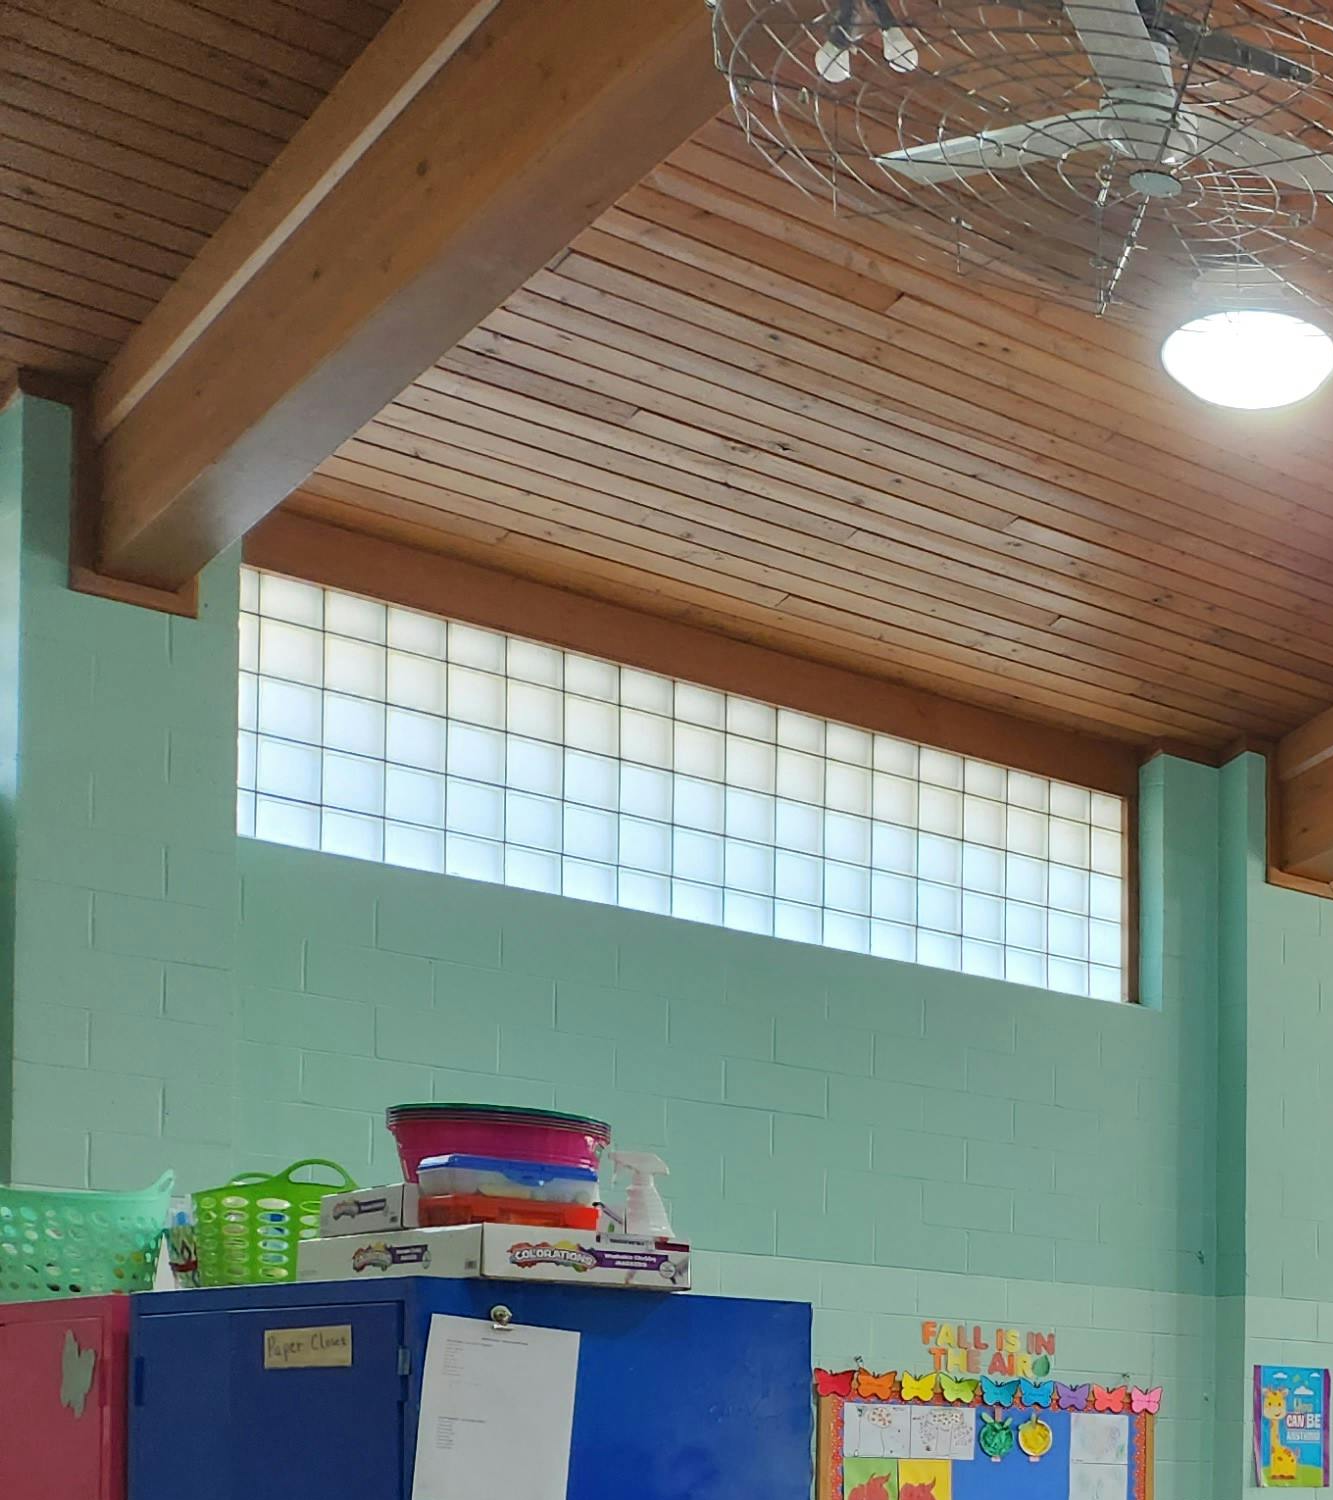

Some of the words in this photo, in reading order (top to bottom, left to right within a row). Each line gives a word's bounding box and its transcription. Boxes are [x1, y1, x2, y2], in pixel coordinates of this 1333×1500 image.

[514, 1247, 596, 1268] COLORATIONS
[267, 1334, 304, 1362] Paper
[921, 1320, 989, 1350] FALL
[995, 1327, 1021, 1353] IS
[1026, 1331, 1056, 1356] IN
[928, 1347, 981, 1374] THE
[988, 1351, 1034, 1378] AIR
[1286, 1413, 1305, 1428] CAN
[1306, 1413, 1321, 1429] BE
